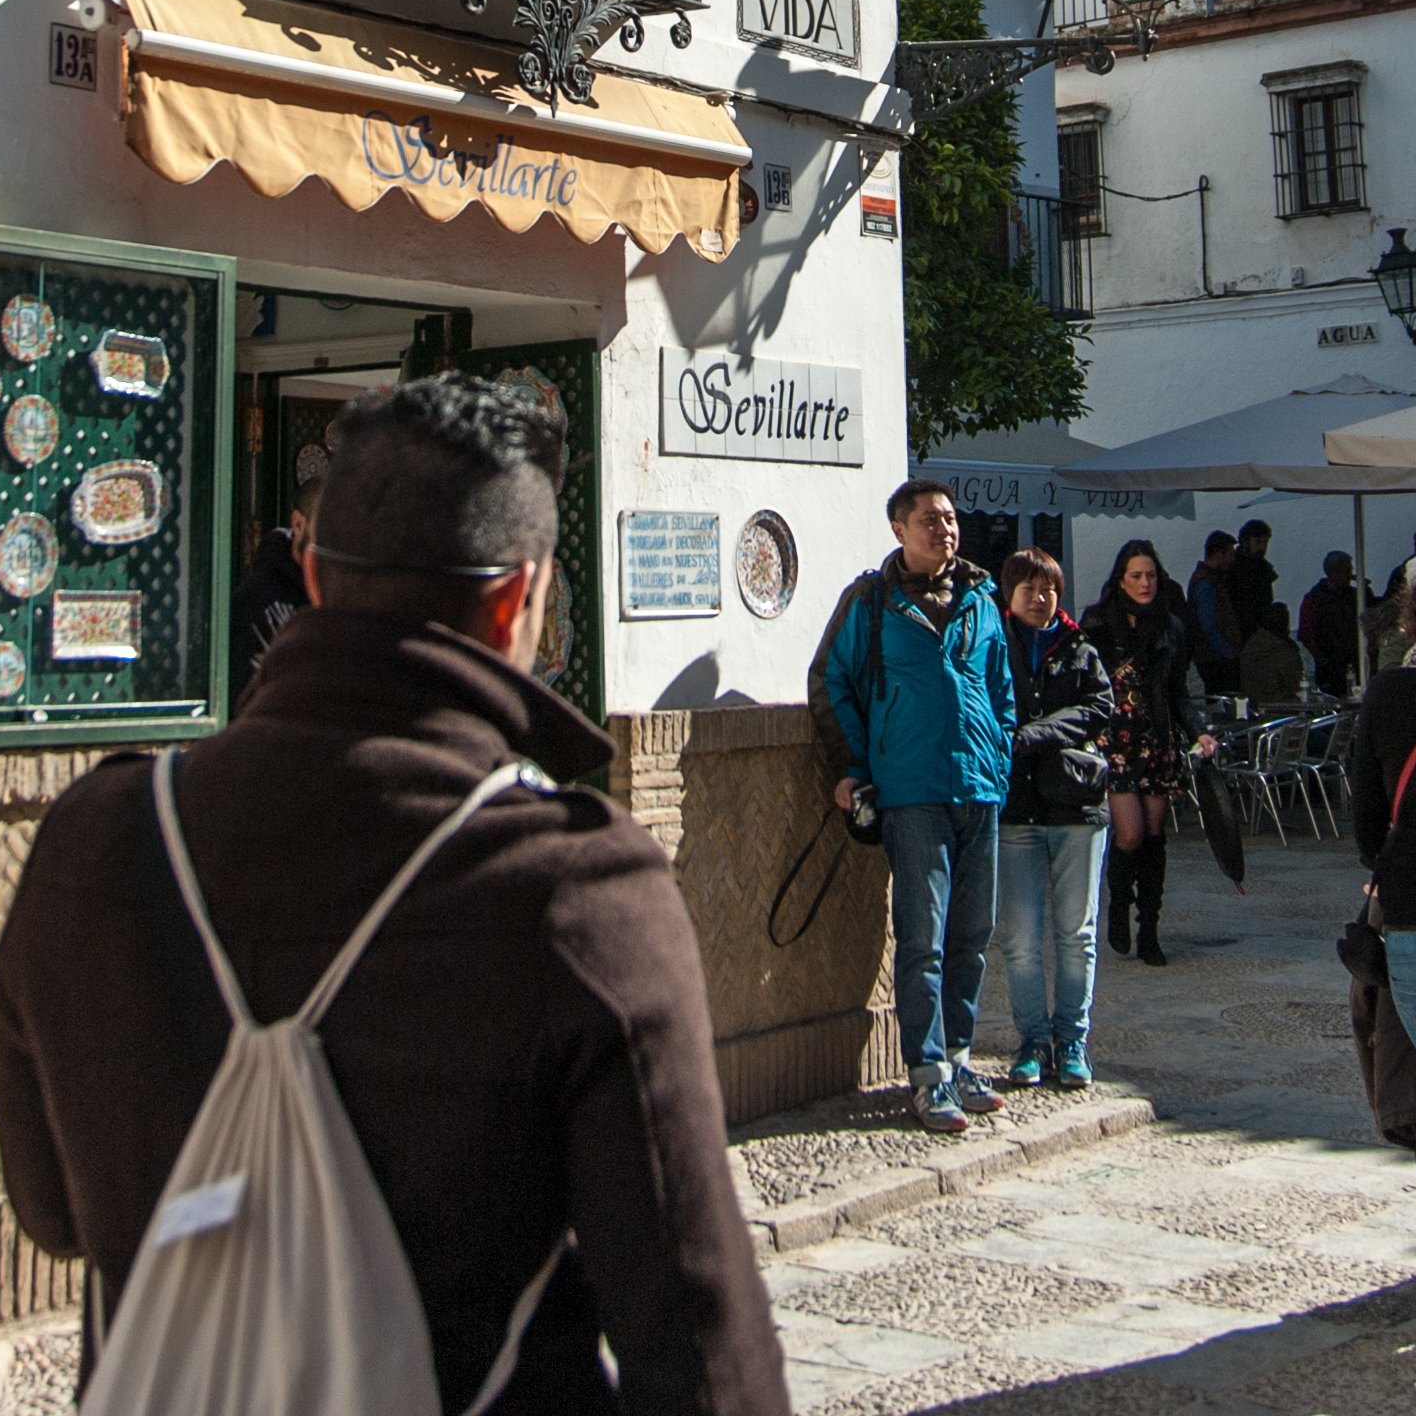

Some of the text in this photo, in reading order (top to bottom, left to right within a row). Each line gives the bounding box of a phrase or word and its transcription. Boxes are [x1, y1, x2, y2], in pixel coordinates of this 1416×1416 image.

[363, 110, 577, 206] Sevillarte
[1318, 325, 1375, 344] AGUA
[679, 362, 849, 441] Sevillarte
[948, 475, 1145, 512] AGUA Y VIDA
[675, 554, 718, 568] NUESTROS
